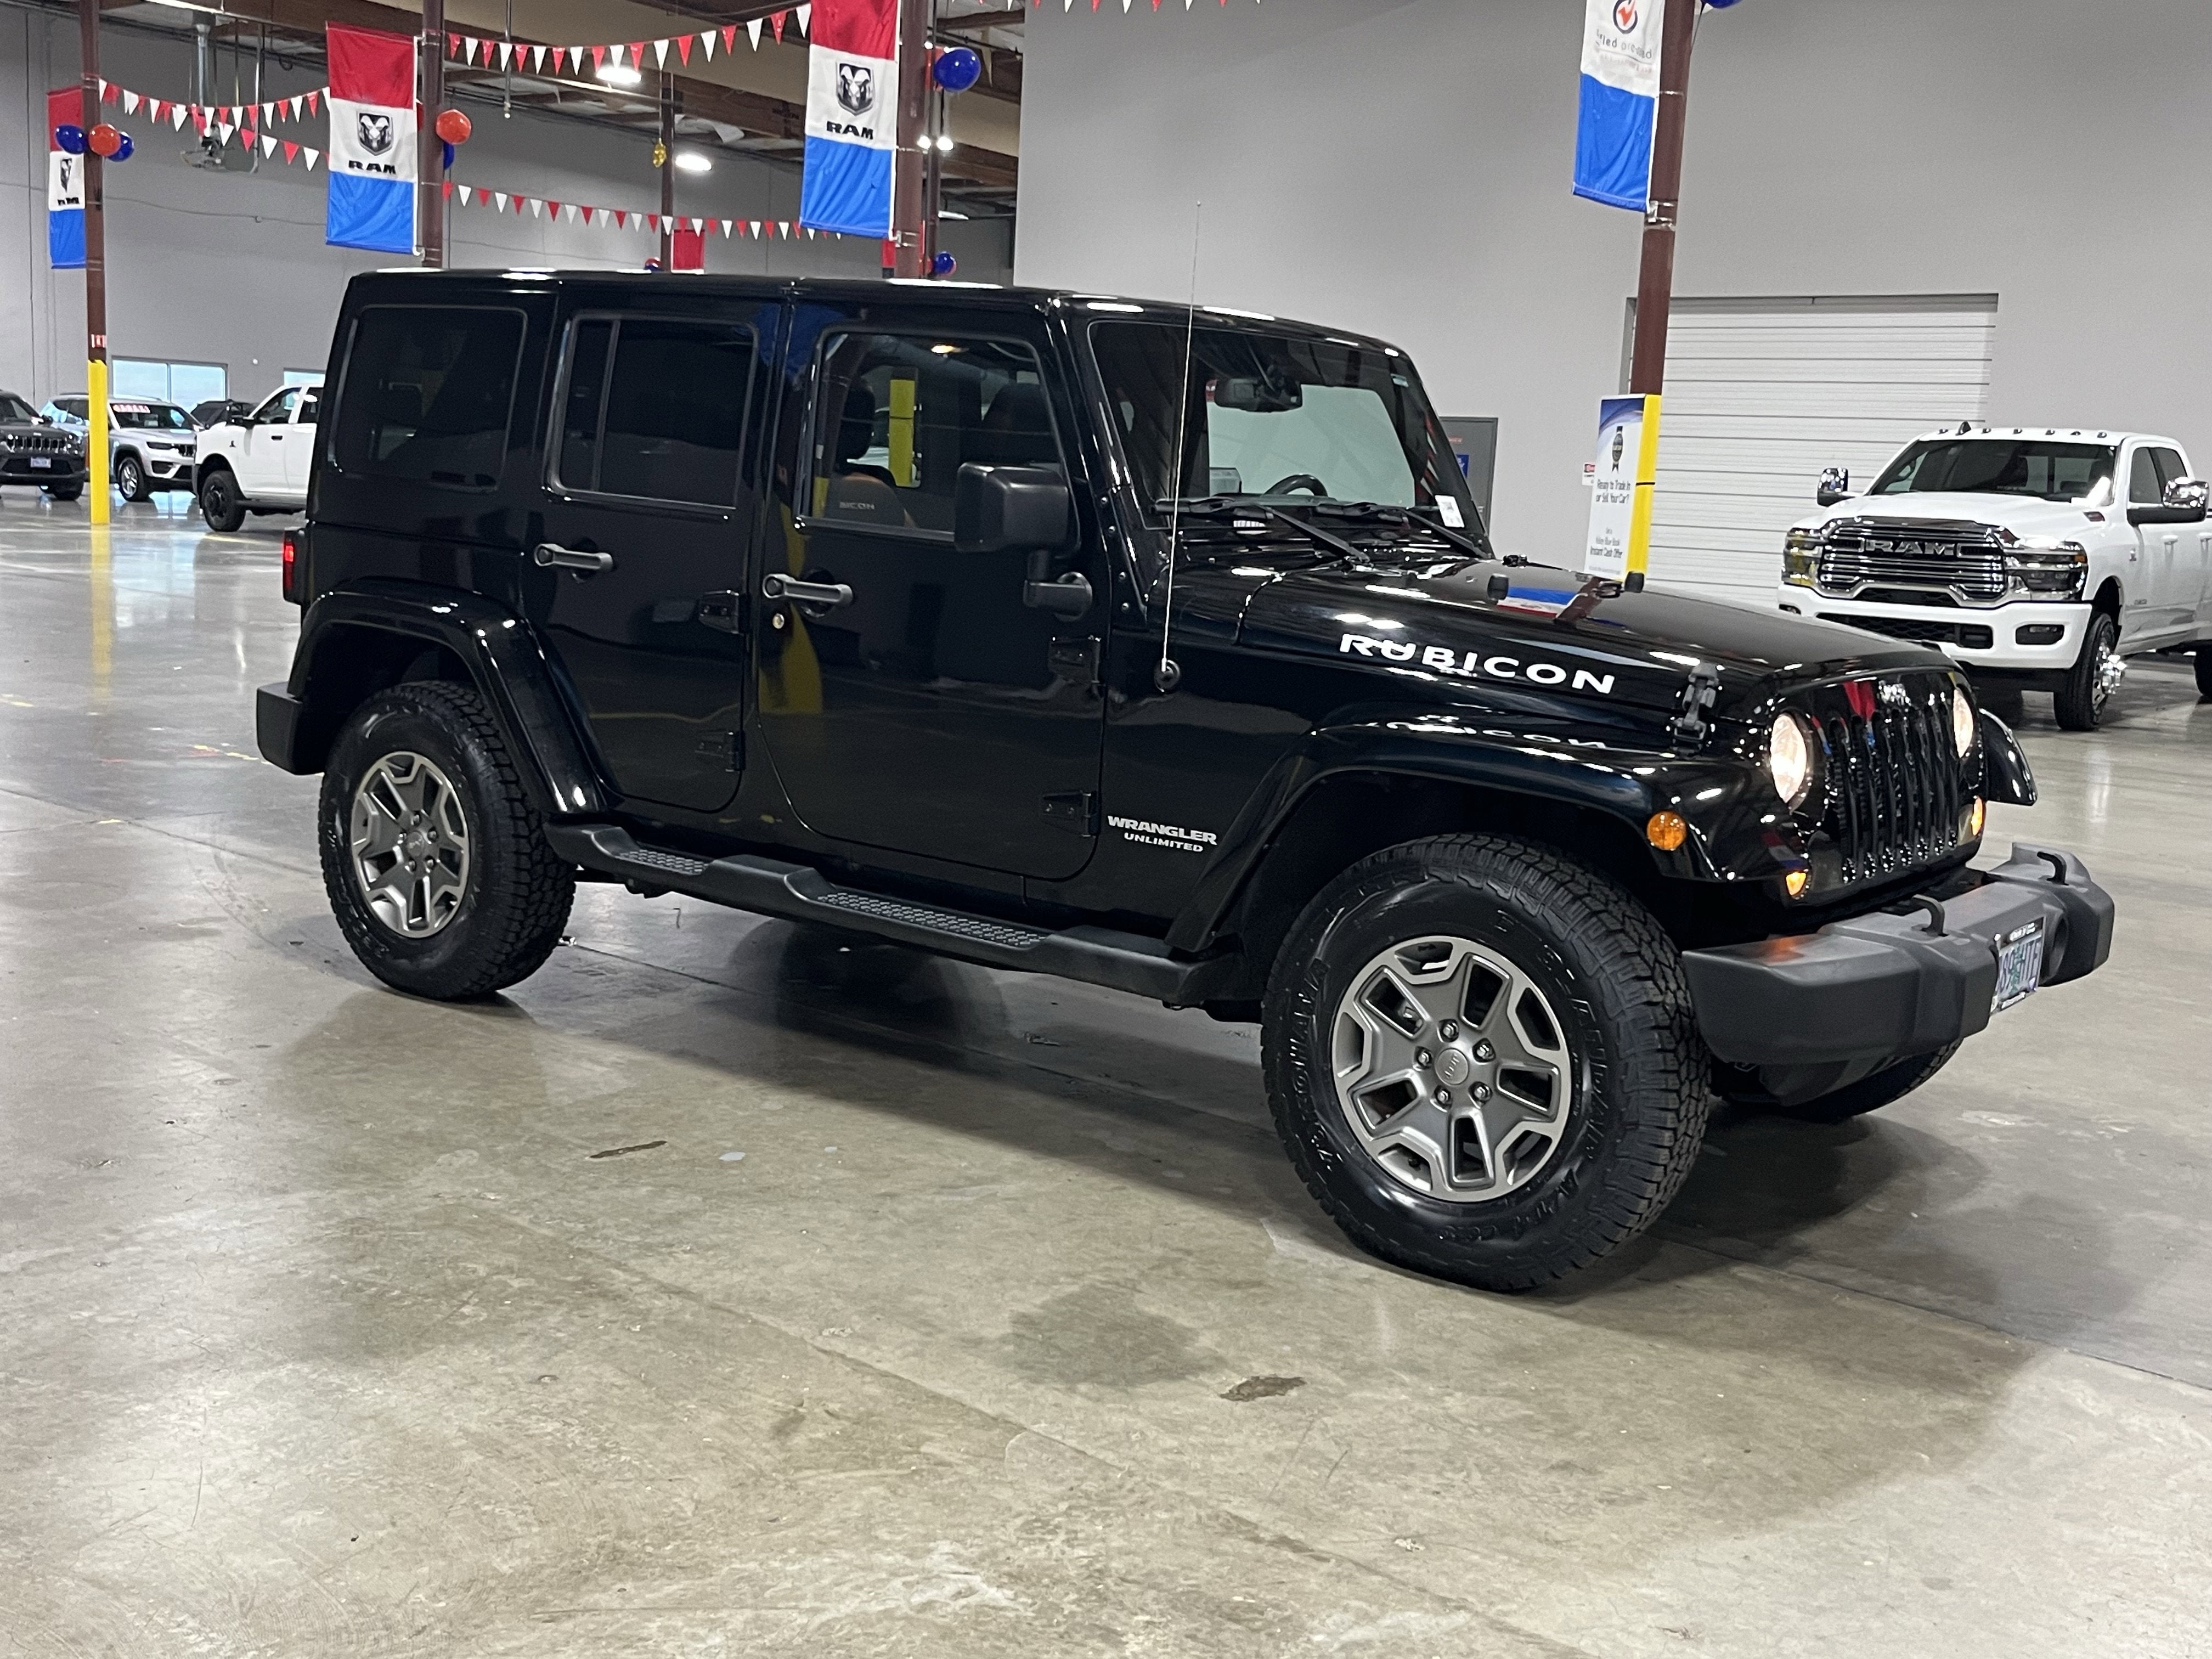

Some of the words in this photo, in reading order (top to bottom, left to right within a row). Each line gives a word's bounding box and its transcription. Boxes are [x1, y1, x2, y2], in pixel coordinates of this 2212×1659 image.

[826, 120, 873, 140] RAM
[348, 160, 396, 175] RAM
[1865, 539, 1954, 556] RAM
[1339, 633, 1615, 695] RUBICON
[1108, 815, 1218, 845] WRANGLER
[1124, 832, 1204, 853] UNLIMITED
